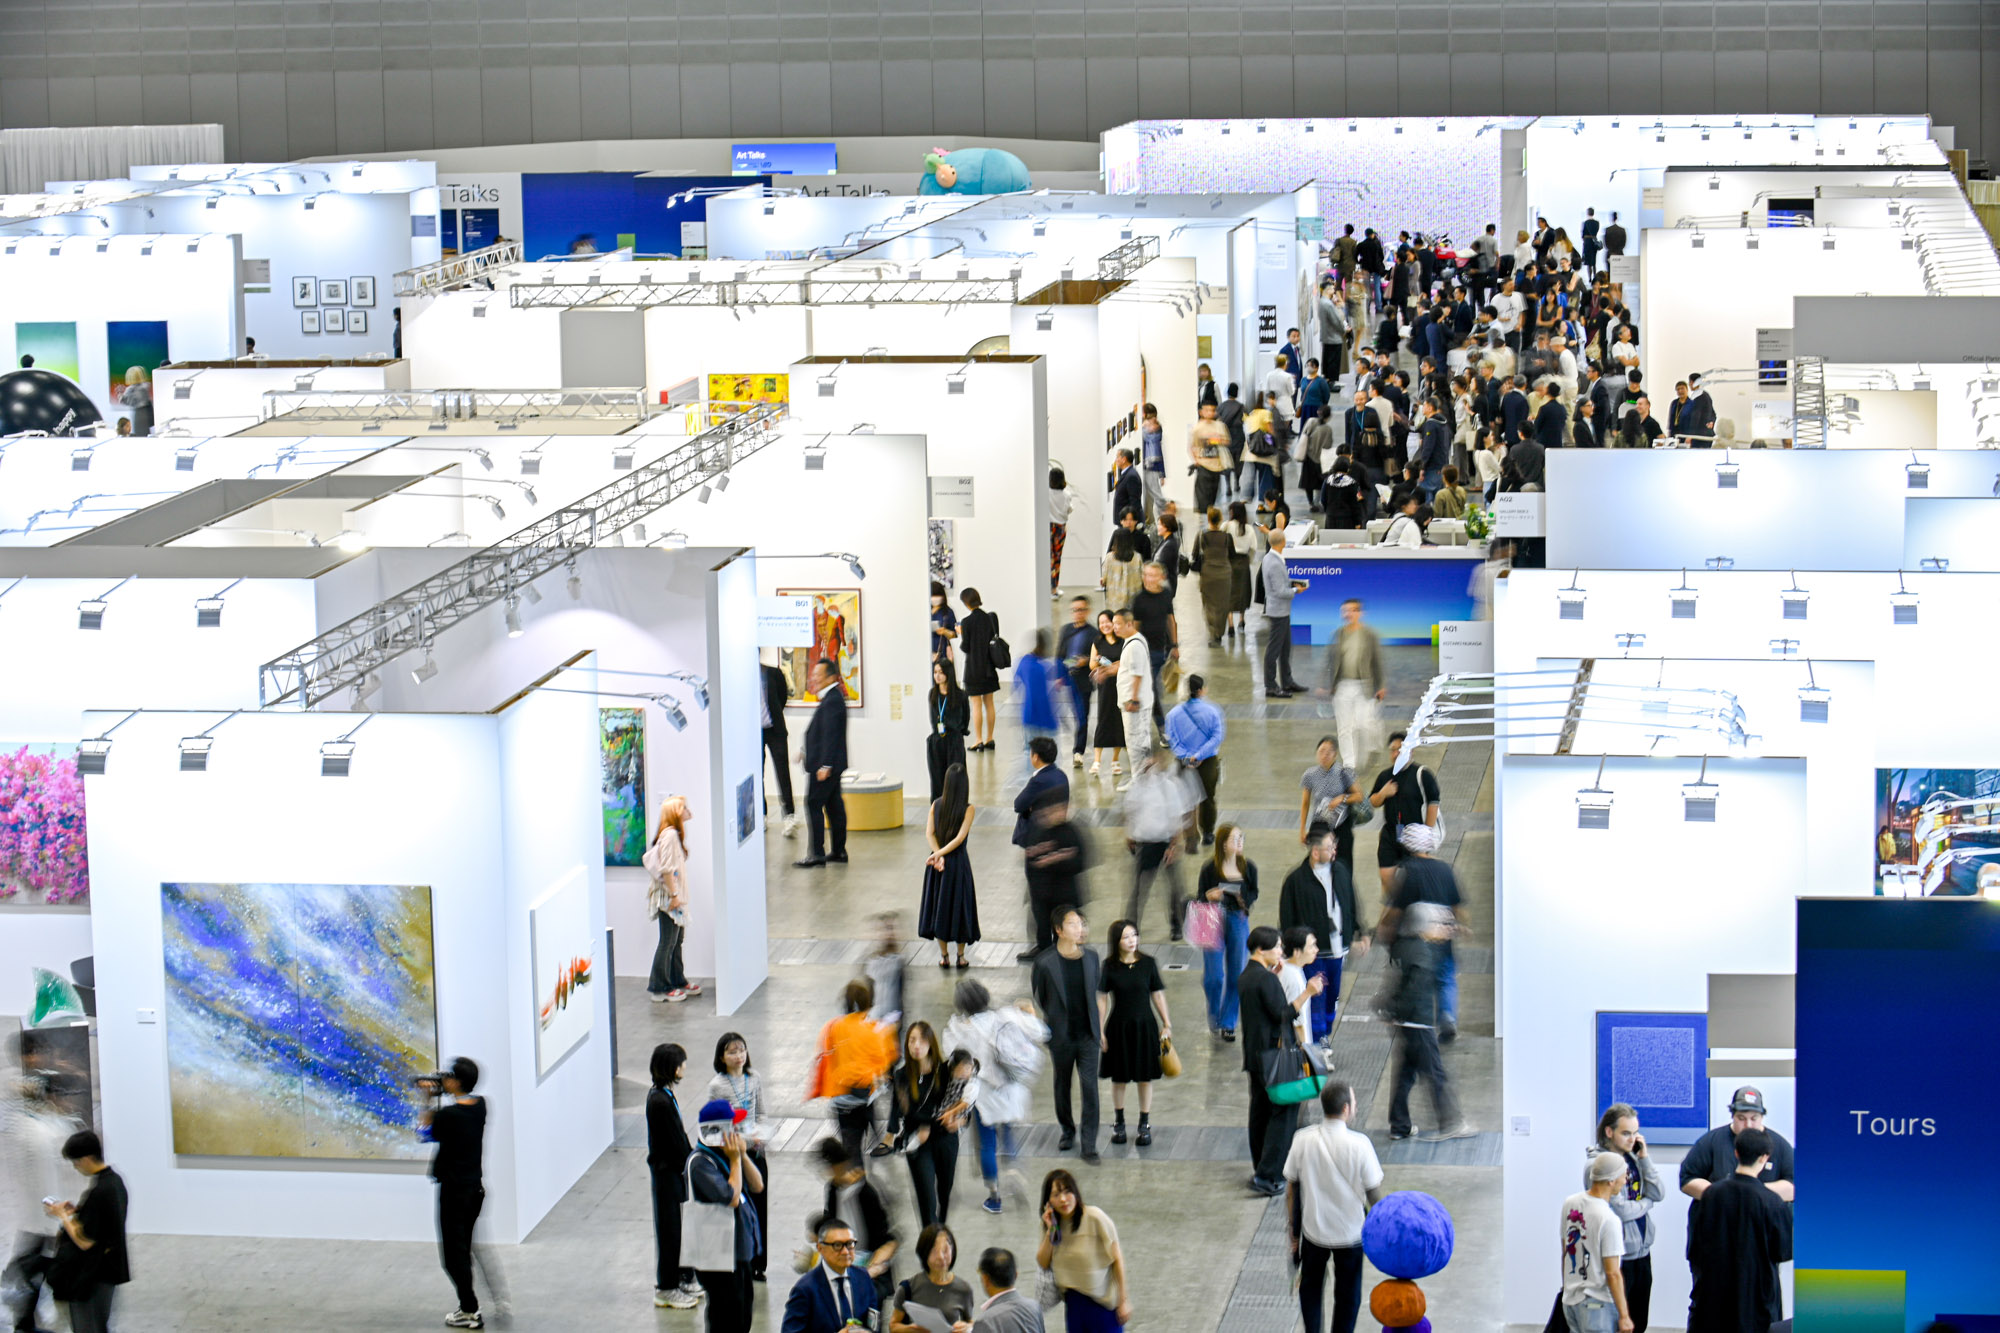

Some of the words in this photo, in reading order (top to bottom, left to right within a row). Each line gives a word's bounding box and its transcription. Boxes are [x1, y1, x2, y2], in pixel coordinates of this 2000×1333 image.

[736, 151, 747, 160] Art
[52, 407, 77, 435] happy
[1286, 565, 1342, 576] nformation
[1849, 1110, 1936, 1136] Tours
